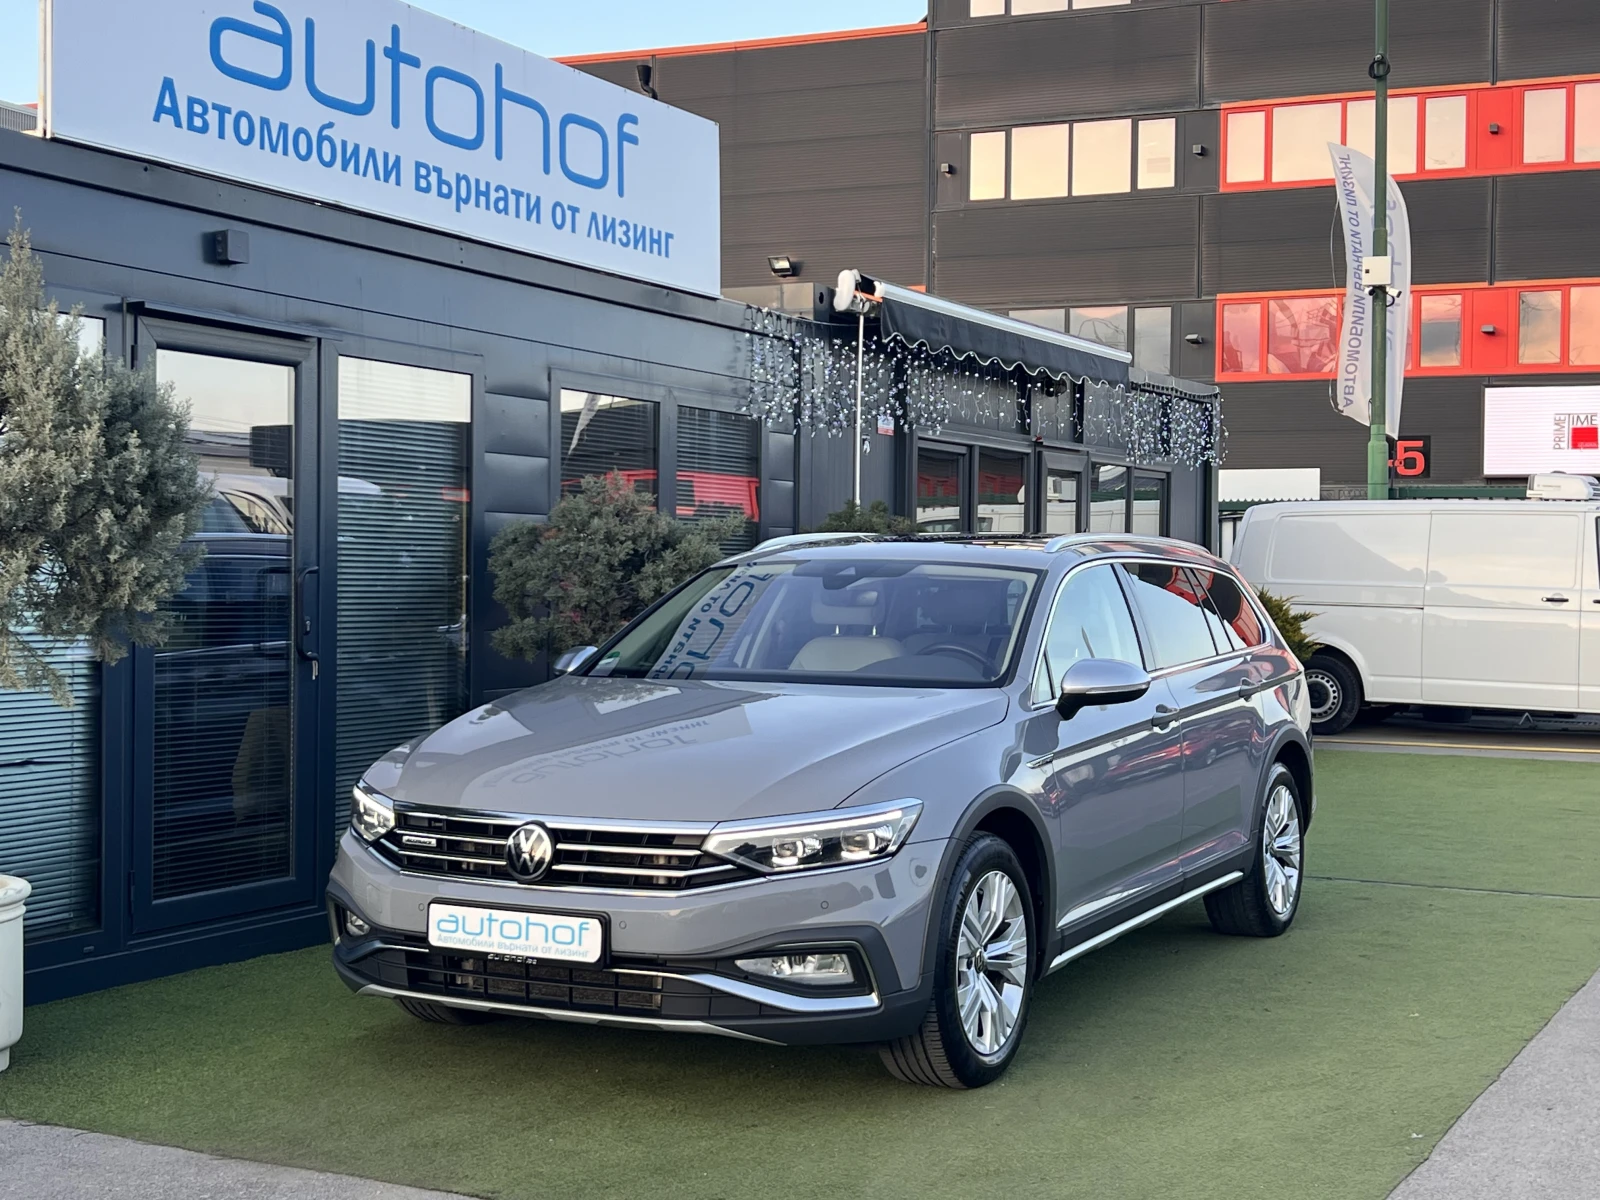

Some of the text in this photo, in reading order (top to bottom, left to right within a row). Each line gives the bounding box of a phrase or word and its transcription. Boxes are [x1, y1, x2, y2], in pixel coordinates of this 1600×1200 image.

[208, 0, 639, 198] autohof
[152, 75, 676, 259] Автомобили върнати от лизинг
[1553, 415, 1567, 450] PRIME
[436, 912, 591, 947] autohof
[436, 933, 590, 959] Автомобили върнати от лизинг
